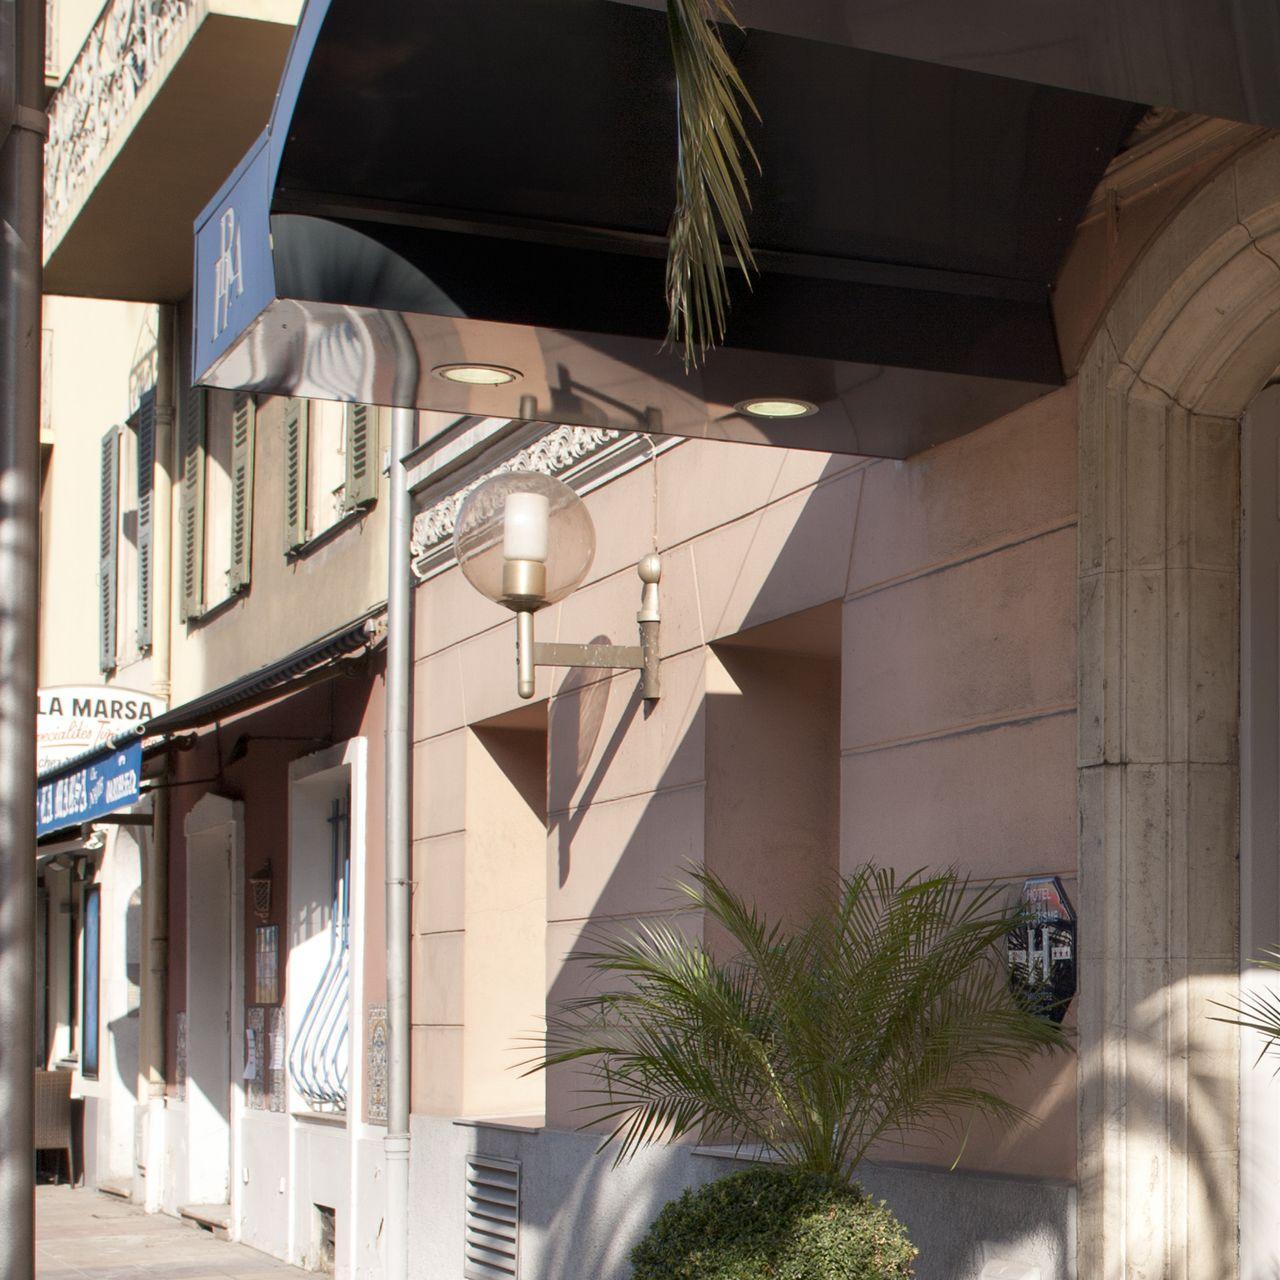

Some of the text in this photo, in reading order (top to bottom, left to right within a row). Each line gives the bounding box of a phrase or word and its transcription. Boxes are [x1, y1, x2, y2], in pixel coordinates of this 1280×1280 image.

[38, 696, 153, 720] LA MARSA
[1026, 888, 1051, 901] HOTEL
